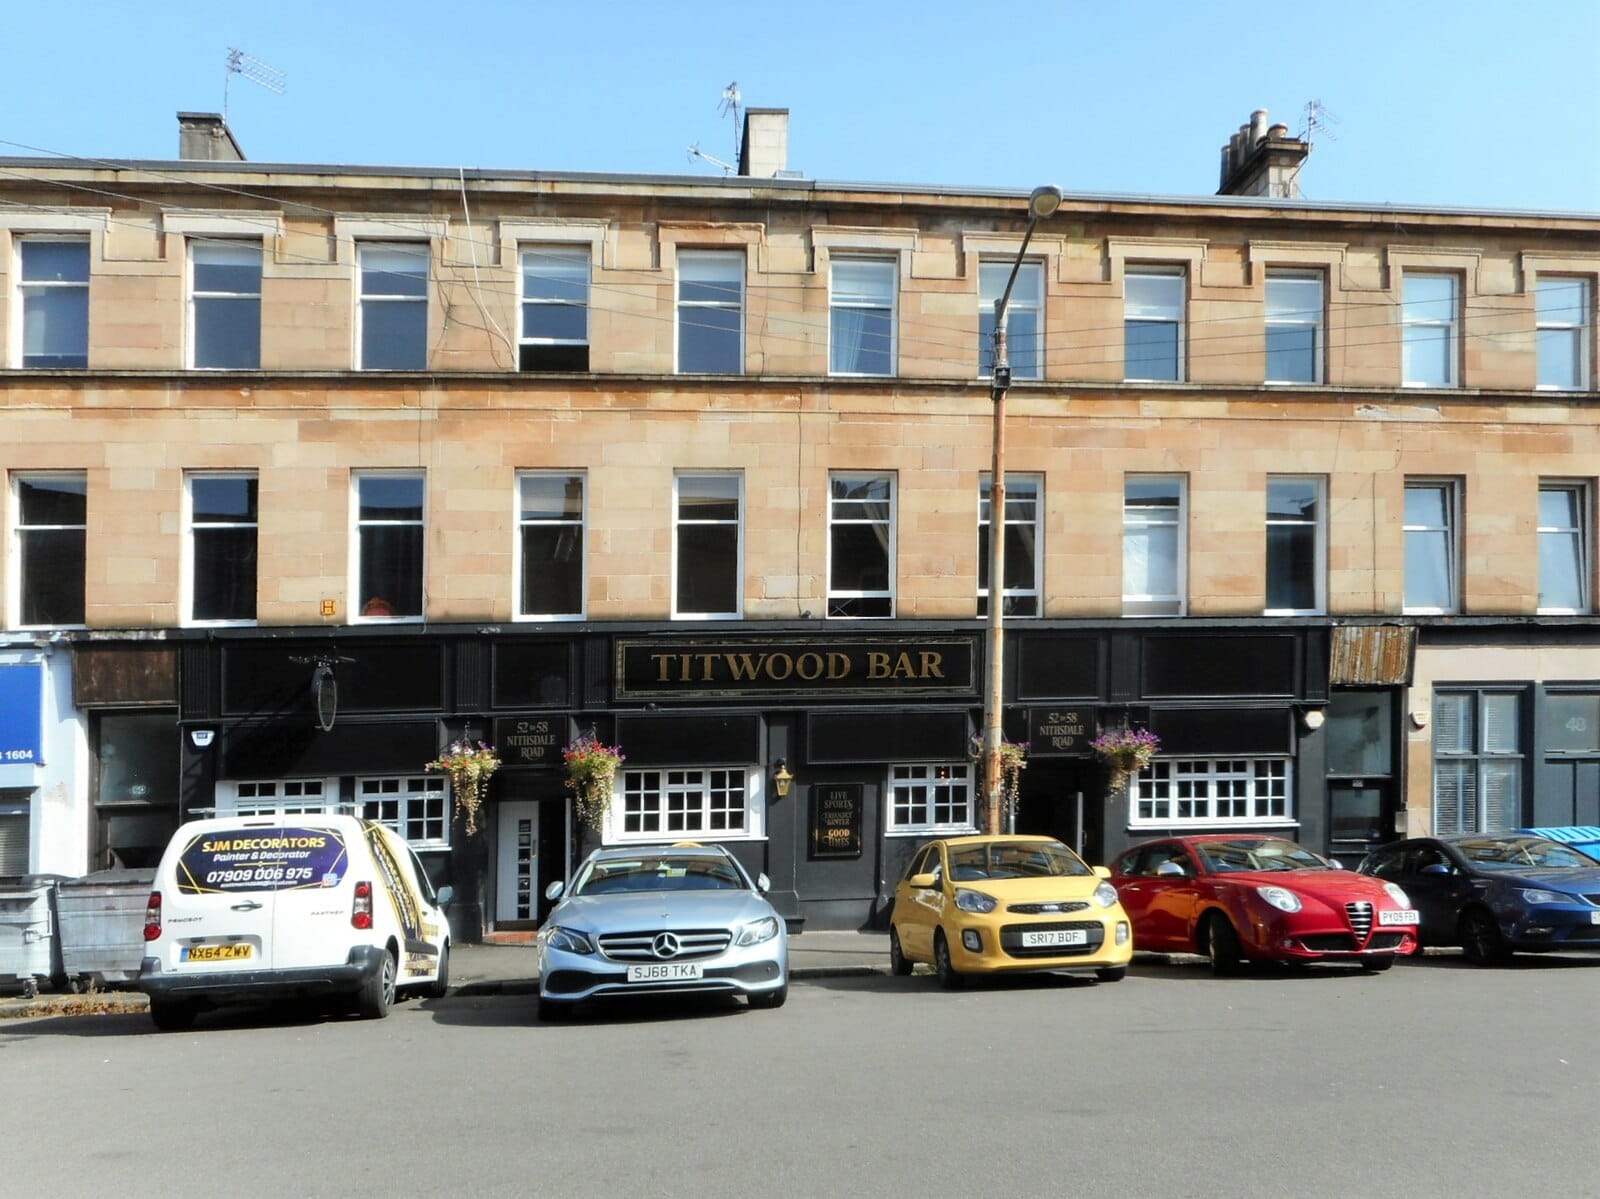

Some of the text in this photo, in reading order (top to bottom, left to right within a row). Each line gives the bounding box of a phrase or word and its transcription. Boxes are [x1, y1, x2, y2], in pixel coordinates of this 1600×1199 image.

[651, 651, 945, 681] TITWOOD BAR
[1048, 712, 1059, 724] 52
[1066, 712, 1078, 723] 58
[516, 721, 529, 734] 52
[536, 721, 549, 733] 58
[1039, 724, 1085, 736] NITHSDALE
[507, 734, 556, 747] NITHSDALE
[1052, 736, 1074, 749] ROAD
[5, 750, 33, 760] 1604
[520, 746, 545, 760] ROAD
[830, 791, 848, 800] LIVE
[824, 799, 853, 809] SPORTS
[828, 828, 850, 837] GOOD
[202, 837, 327, 853] SJM DECORATORS
[213, 850, 311, 863] Painter & Decorator
[206, 867, 314, 884] 07909 006 975
[1029, 931, 1079, 944] SR17 BDF
[188, 944, 251, 960] NX64 ZWV
[634, 964, 698, 978] SJ68 TKA
